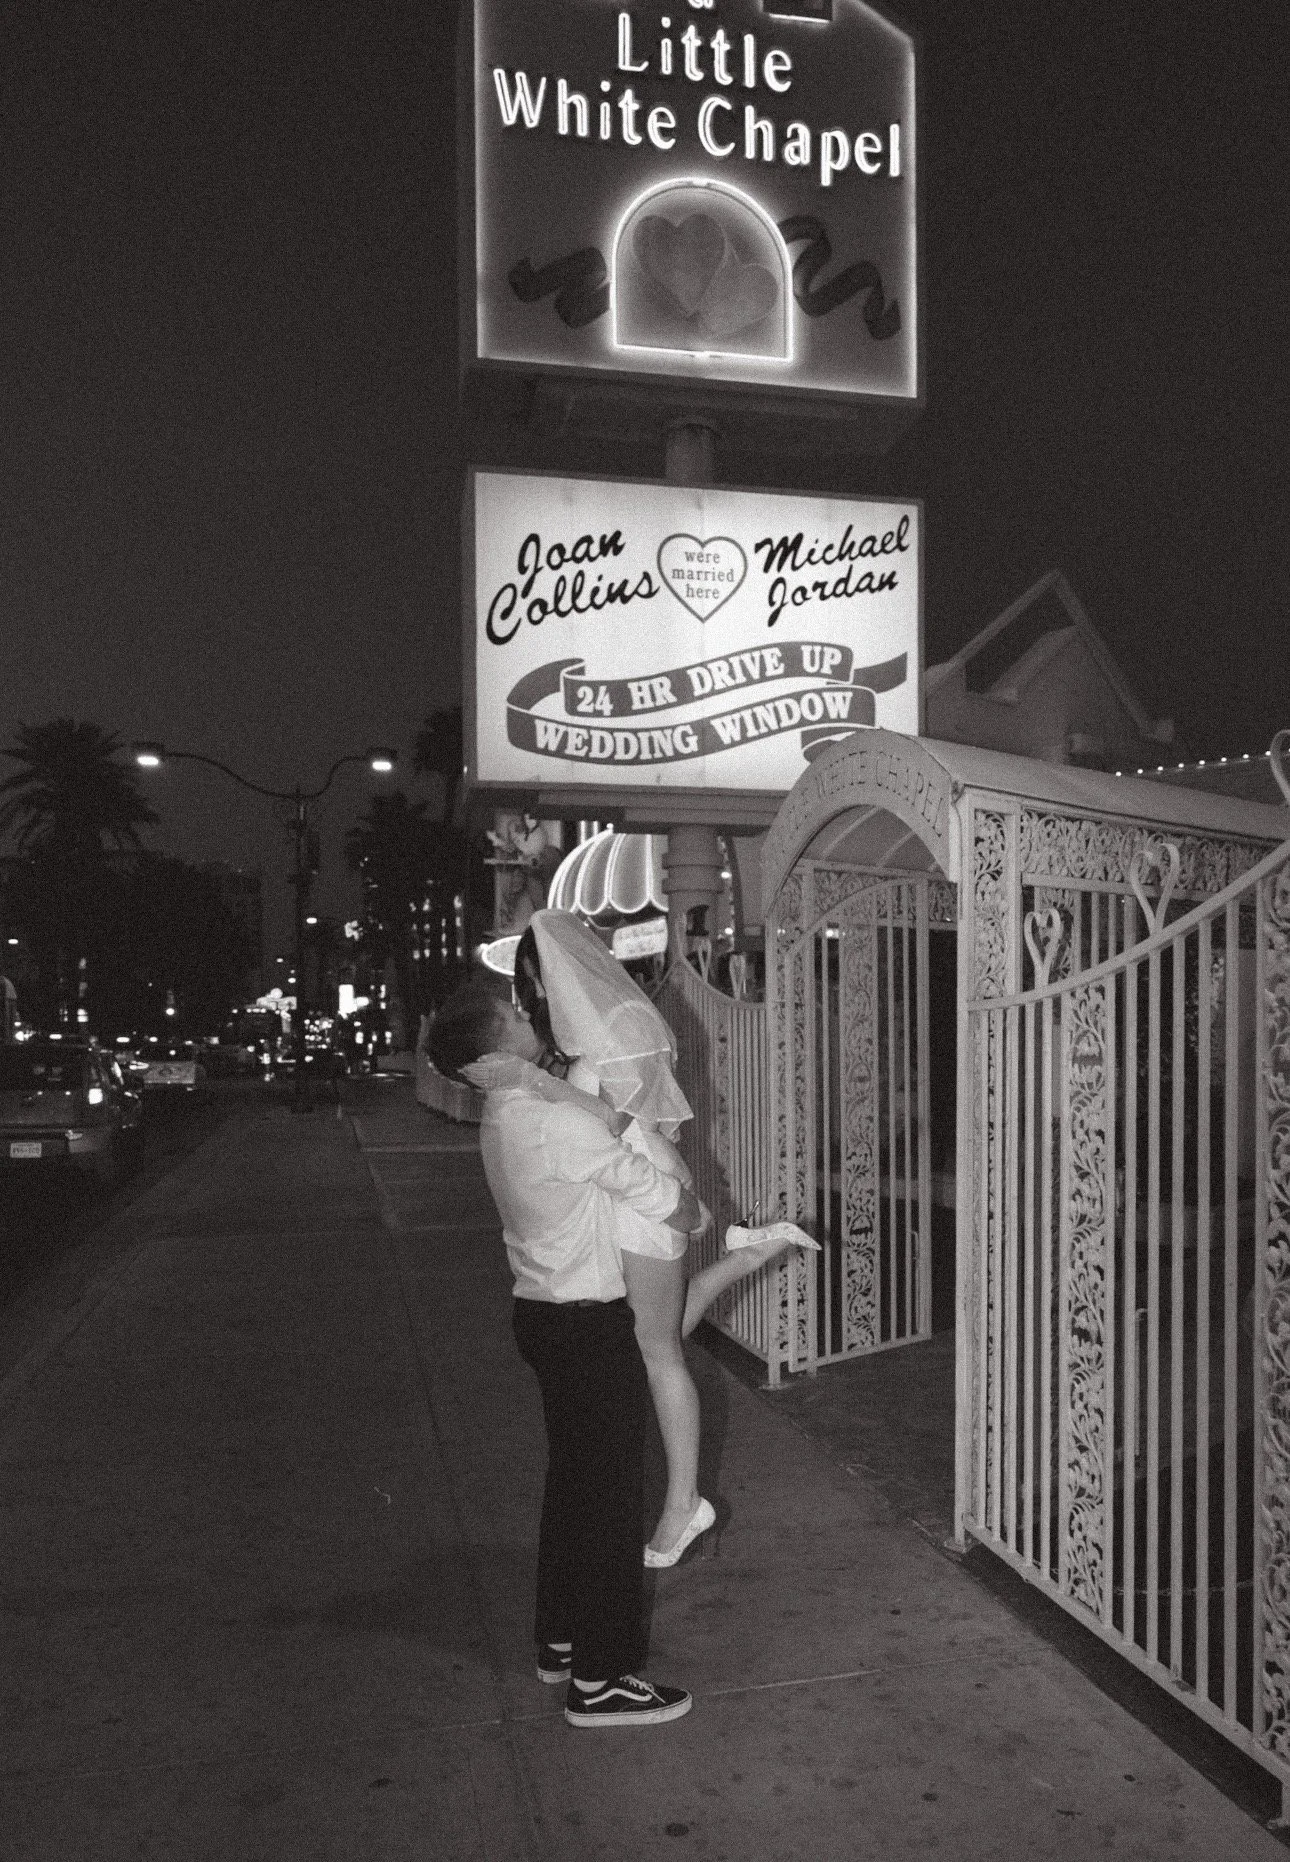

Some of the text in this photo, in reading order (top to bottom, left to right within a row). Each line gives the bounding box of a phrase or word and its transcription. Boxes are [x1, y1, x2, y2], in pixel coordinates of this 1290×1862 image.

[617, 12, 794, 92] Little
[493, 67, 901, 187] White Chapel
[517, 529, 627, 599] Joan
[671, 566, 735, 583] married
[684, 550, 721, 564] were
[754, 514, 910, 574] Michael
[485, 570, 660, 646] Collins
[685, 584, 720, 600] here
[766, 564, 899, 627] Jordan
[576, 644, 843, 717] 24 HR DRIVE UP
[534, 690, 854, 761] WEDDING WINDOW
[875, 750, 945, 841] CHAPEL
